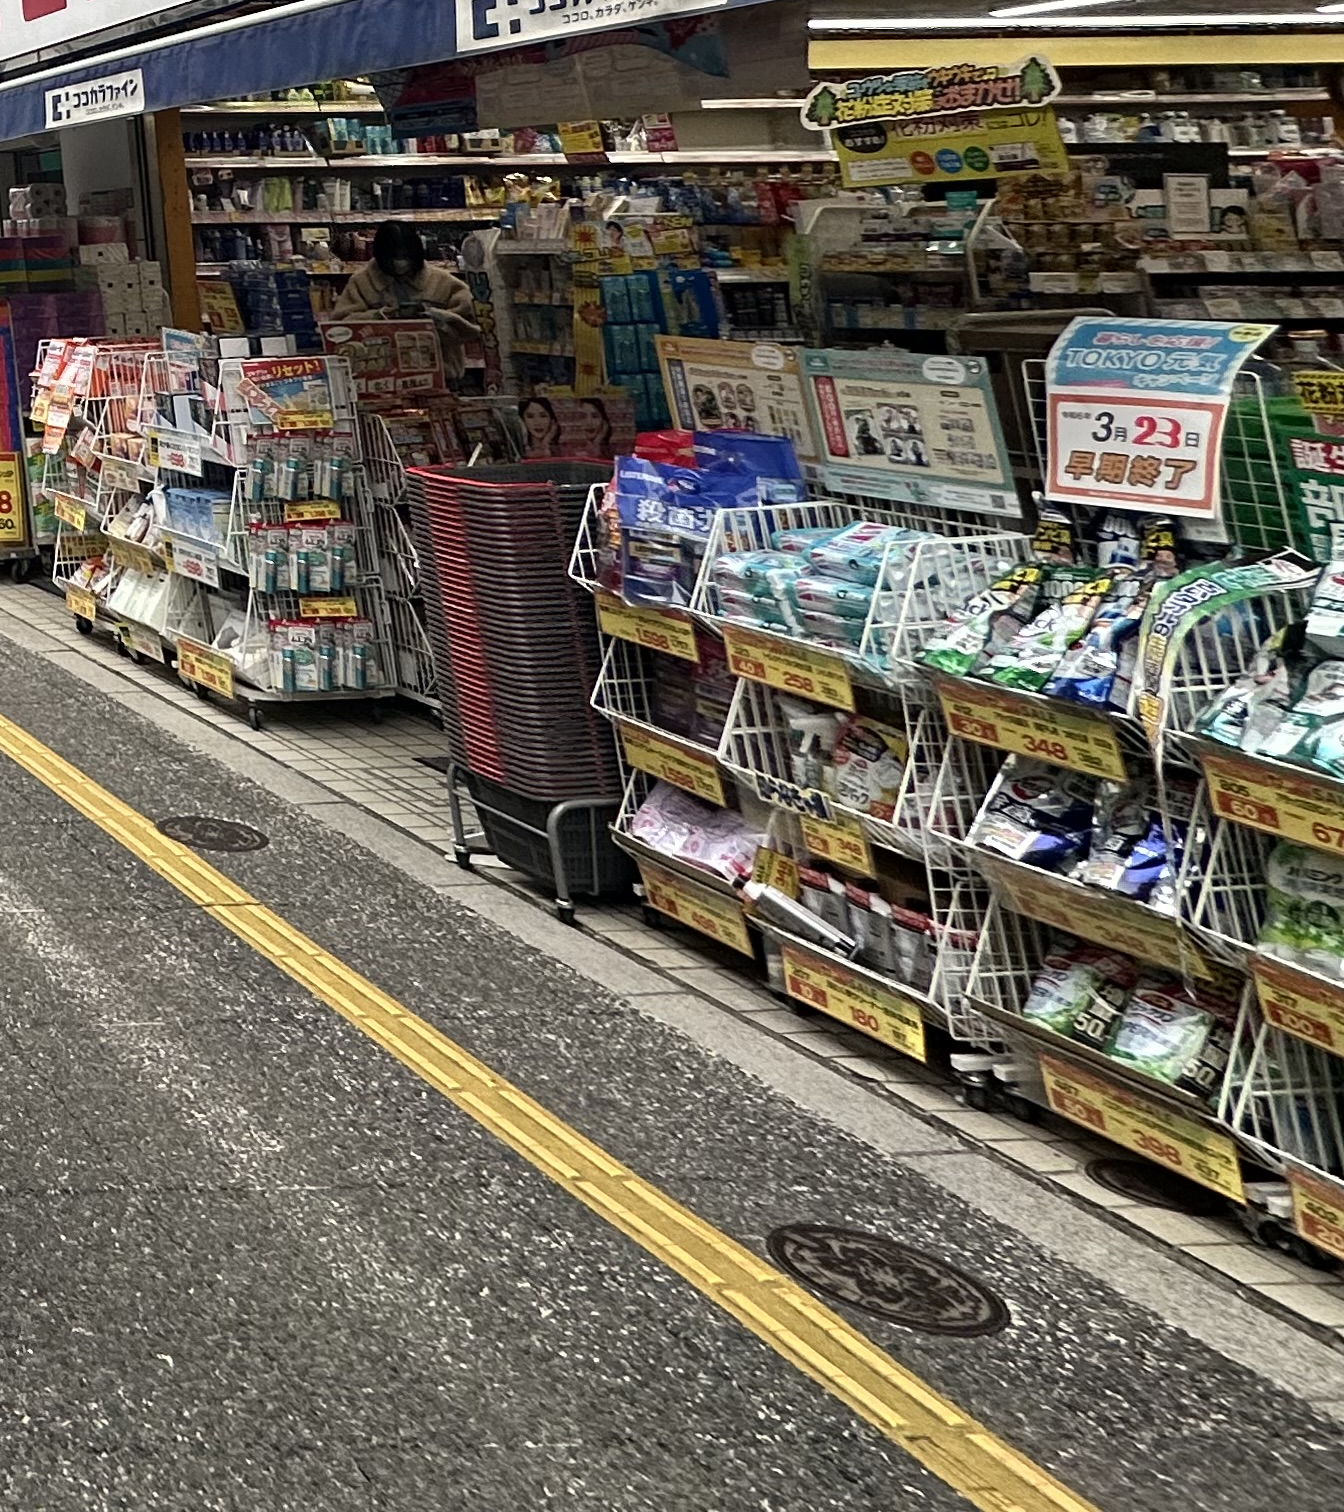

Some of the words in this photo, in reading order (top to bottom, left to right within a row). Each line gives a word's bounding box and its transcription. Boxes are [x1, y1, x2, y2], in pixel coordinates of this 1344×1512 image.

[73, 79, 138, 109] ココカラファイン
[1065, 450, 1197, 490] 早期終了
[783, 671, 814, 693] 258
[1021, 734, 1069, 761] 348
[1231, 799, 1259, 819] 60
[849, 1005, 880, 1032] 180
[1131, 1129, 1182, 1166] 398
